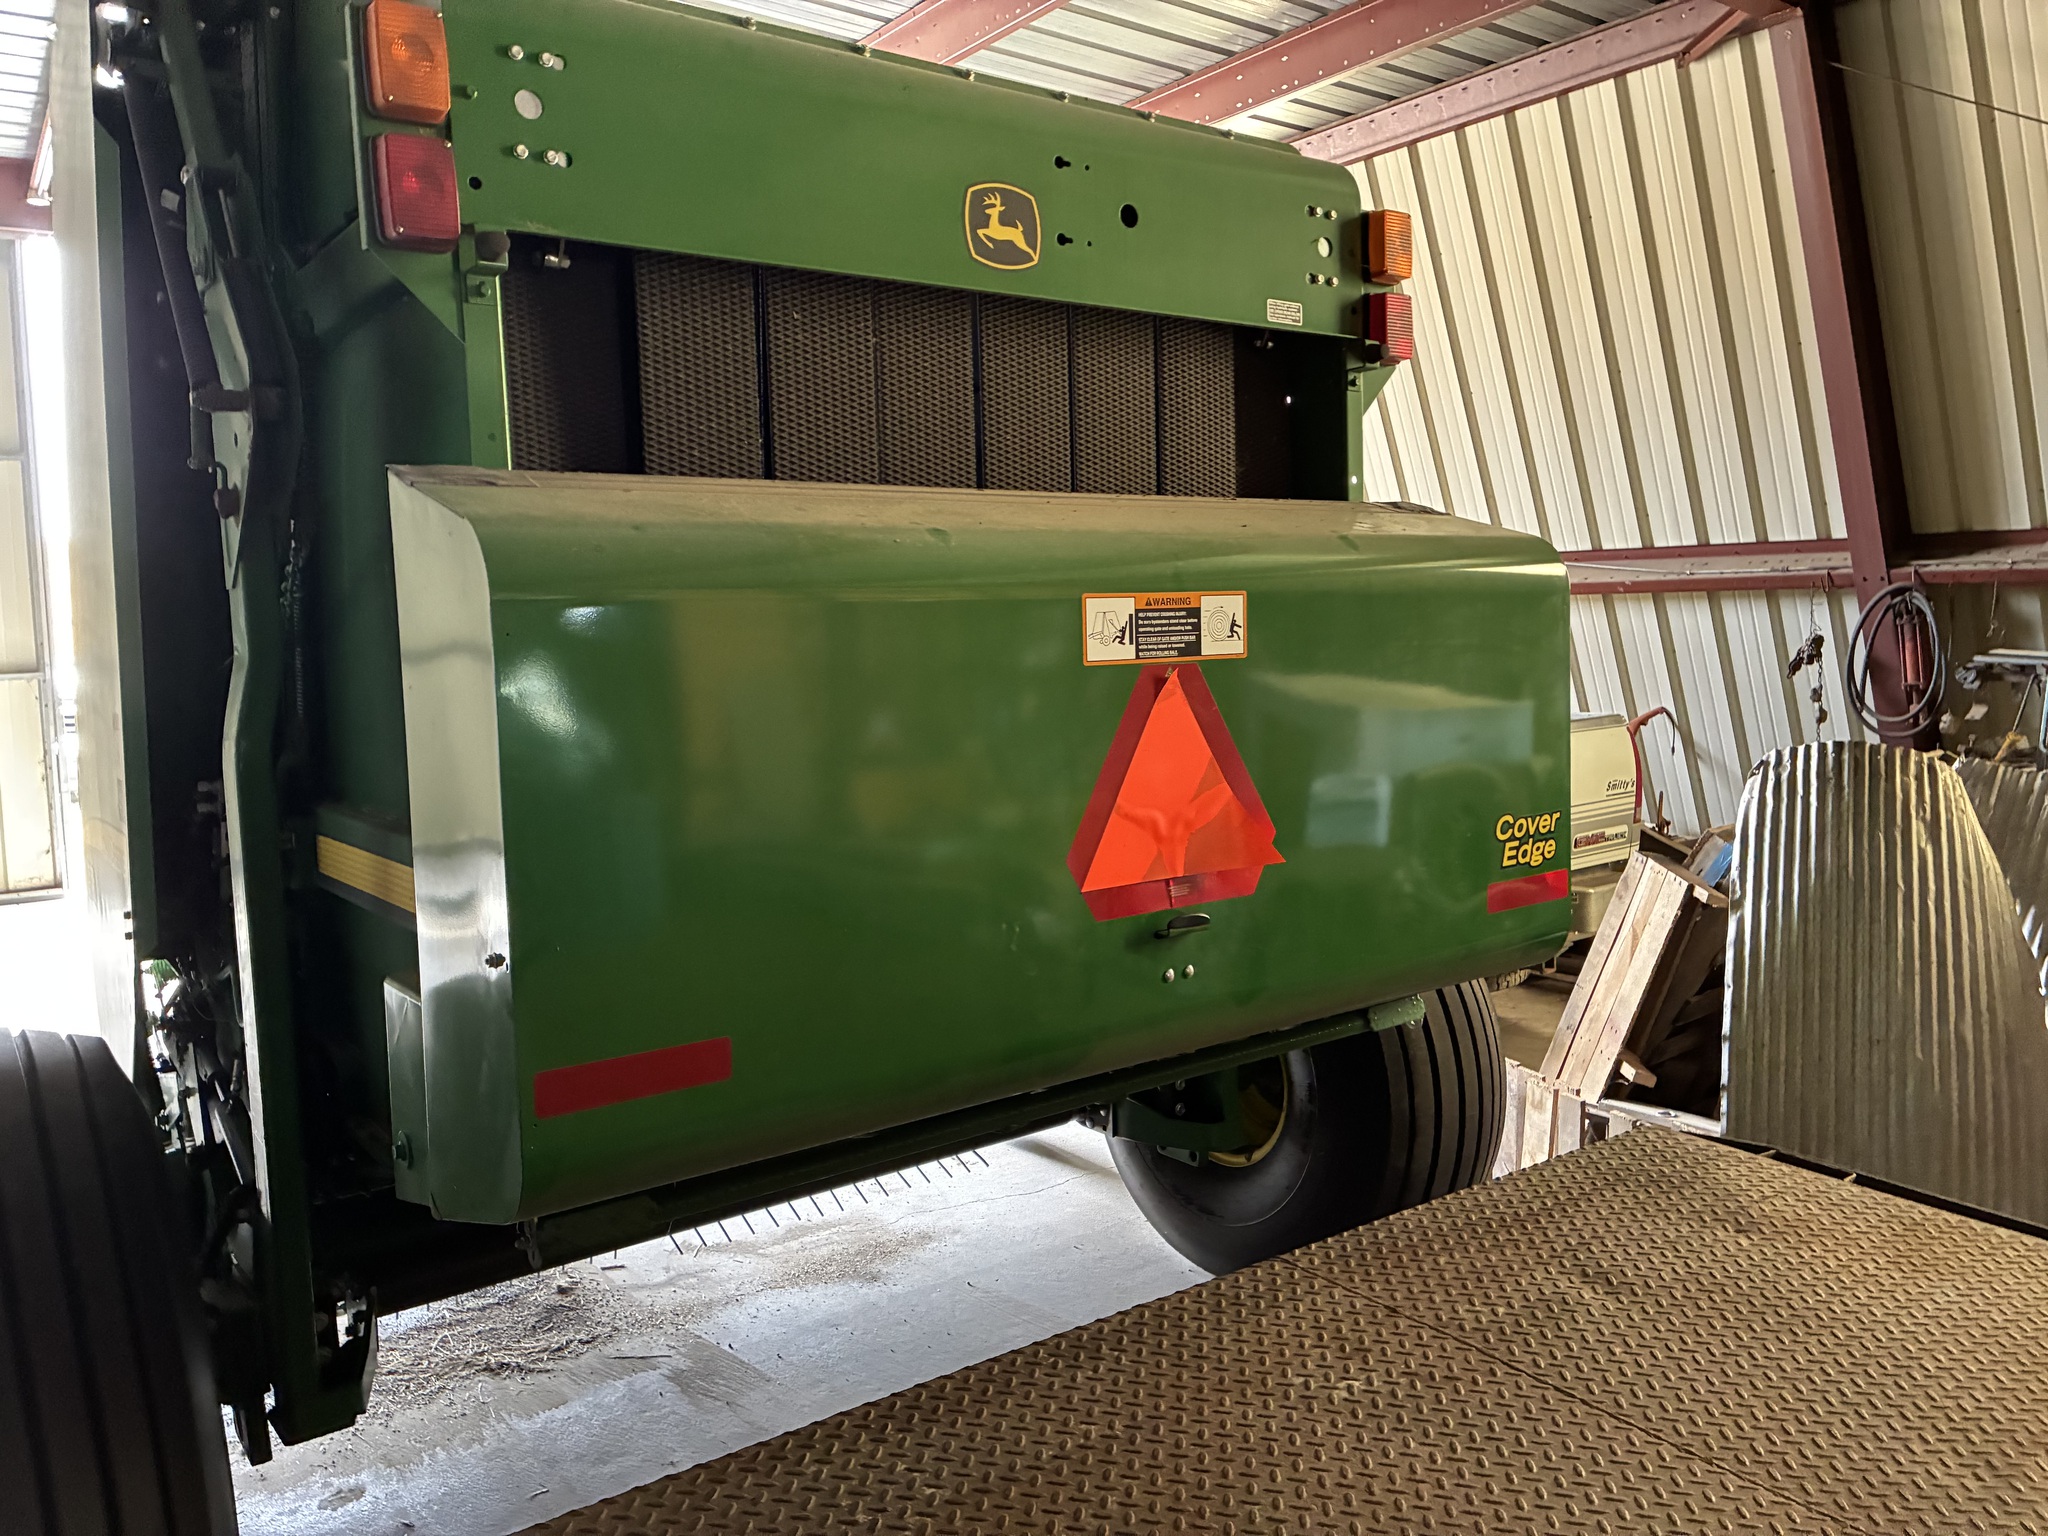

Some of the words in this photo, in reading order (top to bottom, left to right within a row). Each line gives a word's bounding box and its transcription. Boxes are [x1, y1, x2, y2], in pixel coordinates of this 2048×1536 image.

[1152, 597, 1191, 606] WARNING
[1606, 778, 1636, 792] Smitty's
[1495, 811, 1561, 841] Cover
[1502, 838, 1556, 867] Edge
